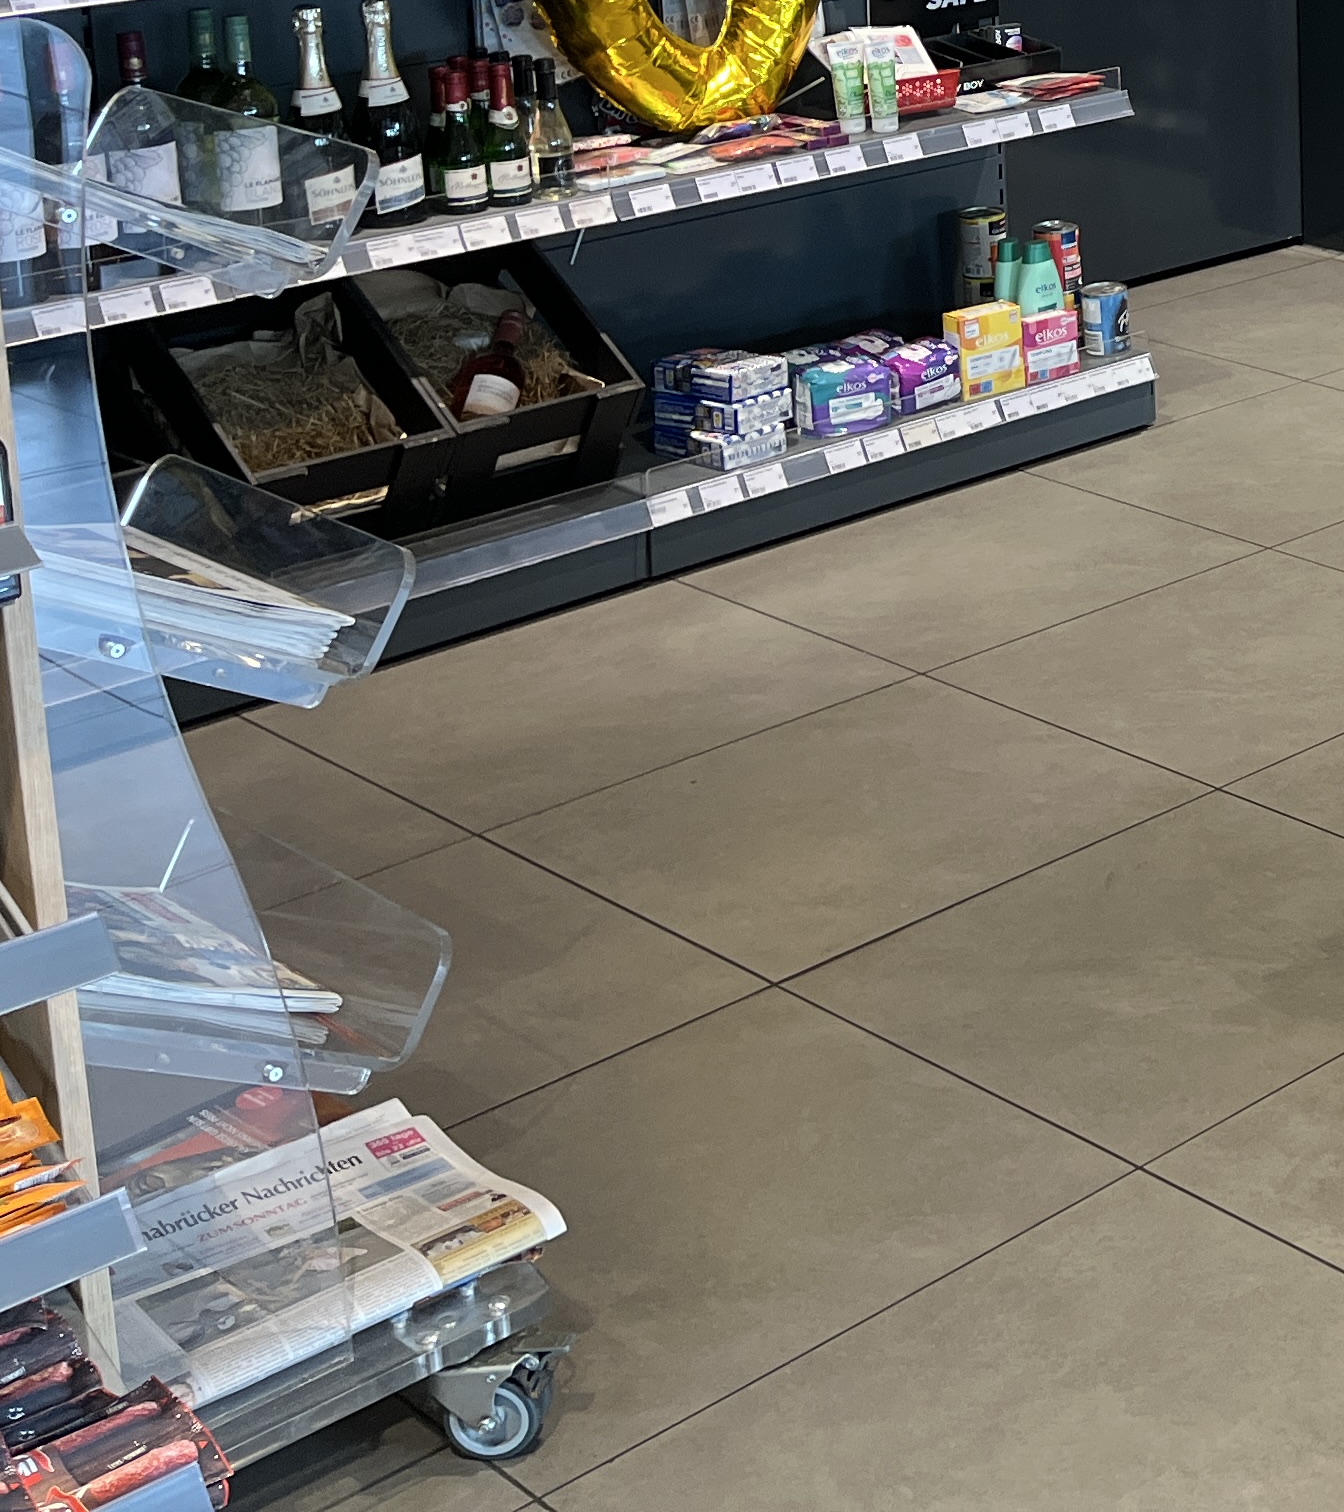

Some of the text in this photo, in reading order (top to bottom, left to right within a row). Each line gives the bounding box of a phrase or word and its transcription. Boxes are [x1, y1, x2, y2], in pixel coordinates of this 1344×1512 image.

[1036, 325, 1067, 342] elkos
[921, 364, 948, 381] elkos
[836, 380, 867, 393] elkos
[141, 1198, 240, 1242] nabrücker
[241, 1153, 363, 1205] Nachrichten
